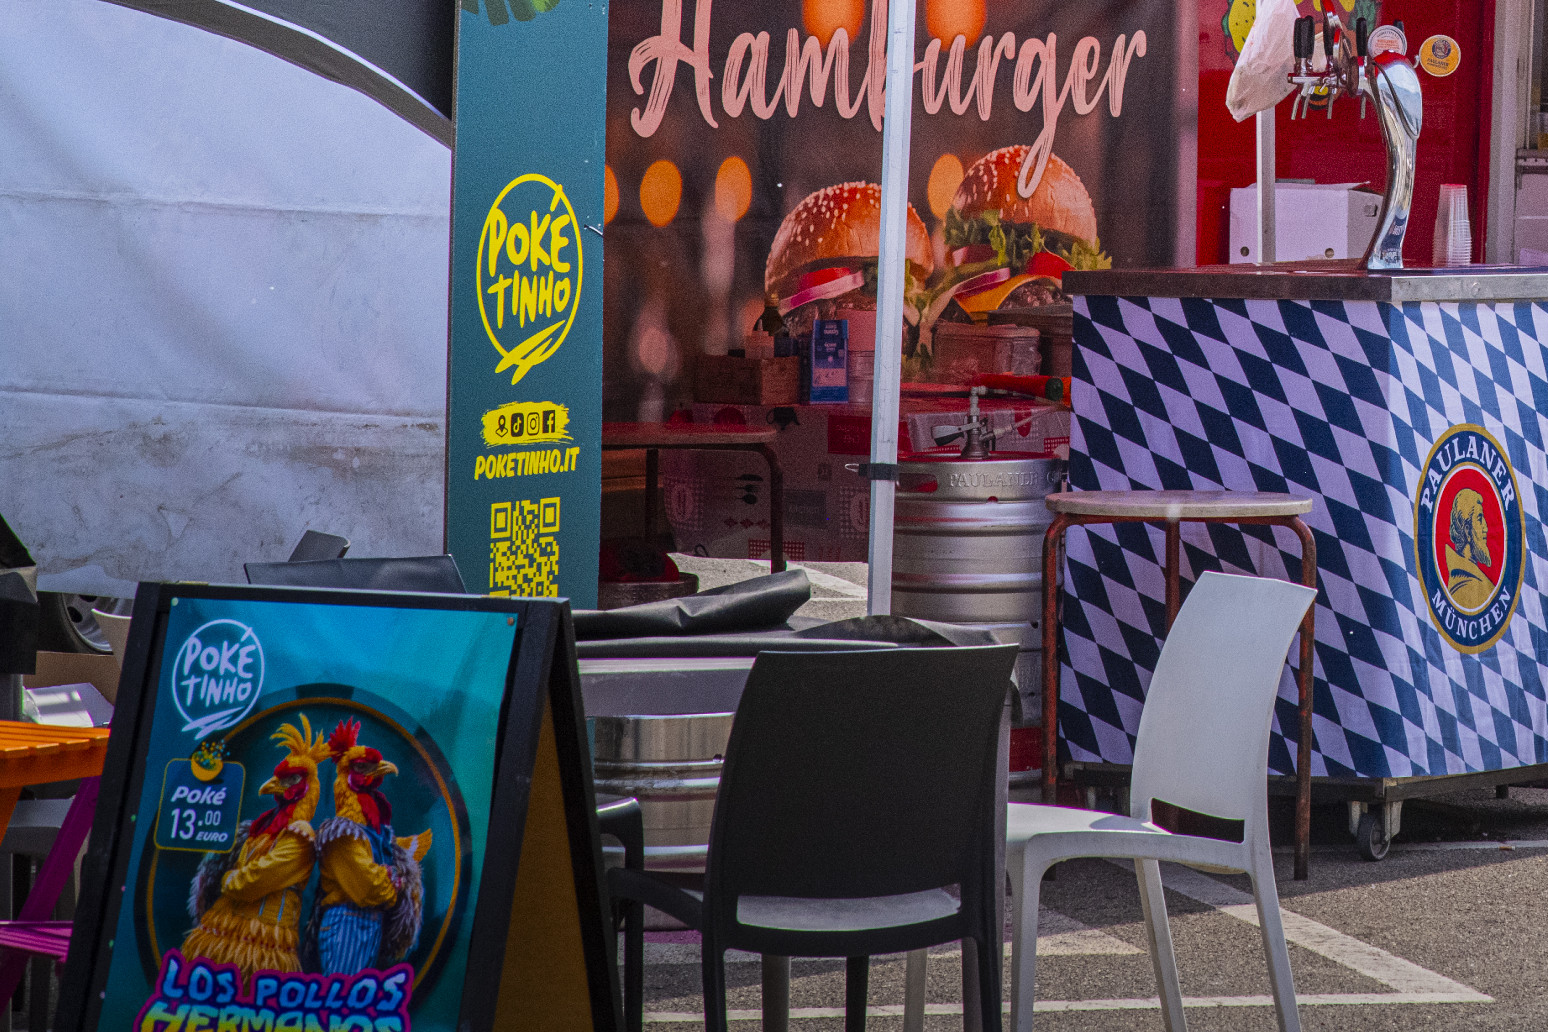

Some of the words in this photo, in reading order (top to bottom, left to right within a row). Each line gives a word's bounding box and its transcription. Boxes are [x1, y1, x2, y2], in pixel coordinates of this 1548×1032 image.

[487, 270, 571, 329] TINHO
[474, 447, 580, 481] POKETINHO.IT
[1420, 435, 1517, 514] PAULANER
[1431, 585, 1512, 641] MÜNCHEN
[181, 673, 253, 708] TINHO
[170, 786, 227, 806] Poké
[195, 831, 229, 843] EURO
[163, 958, 236, 1004] LOS
[256, 972, 406, 1012] POLLOS
[140, 1001, 403, 1032] HERMANOS
